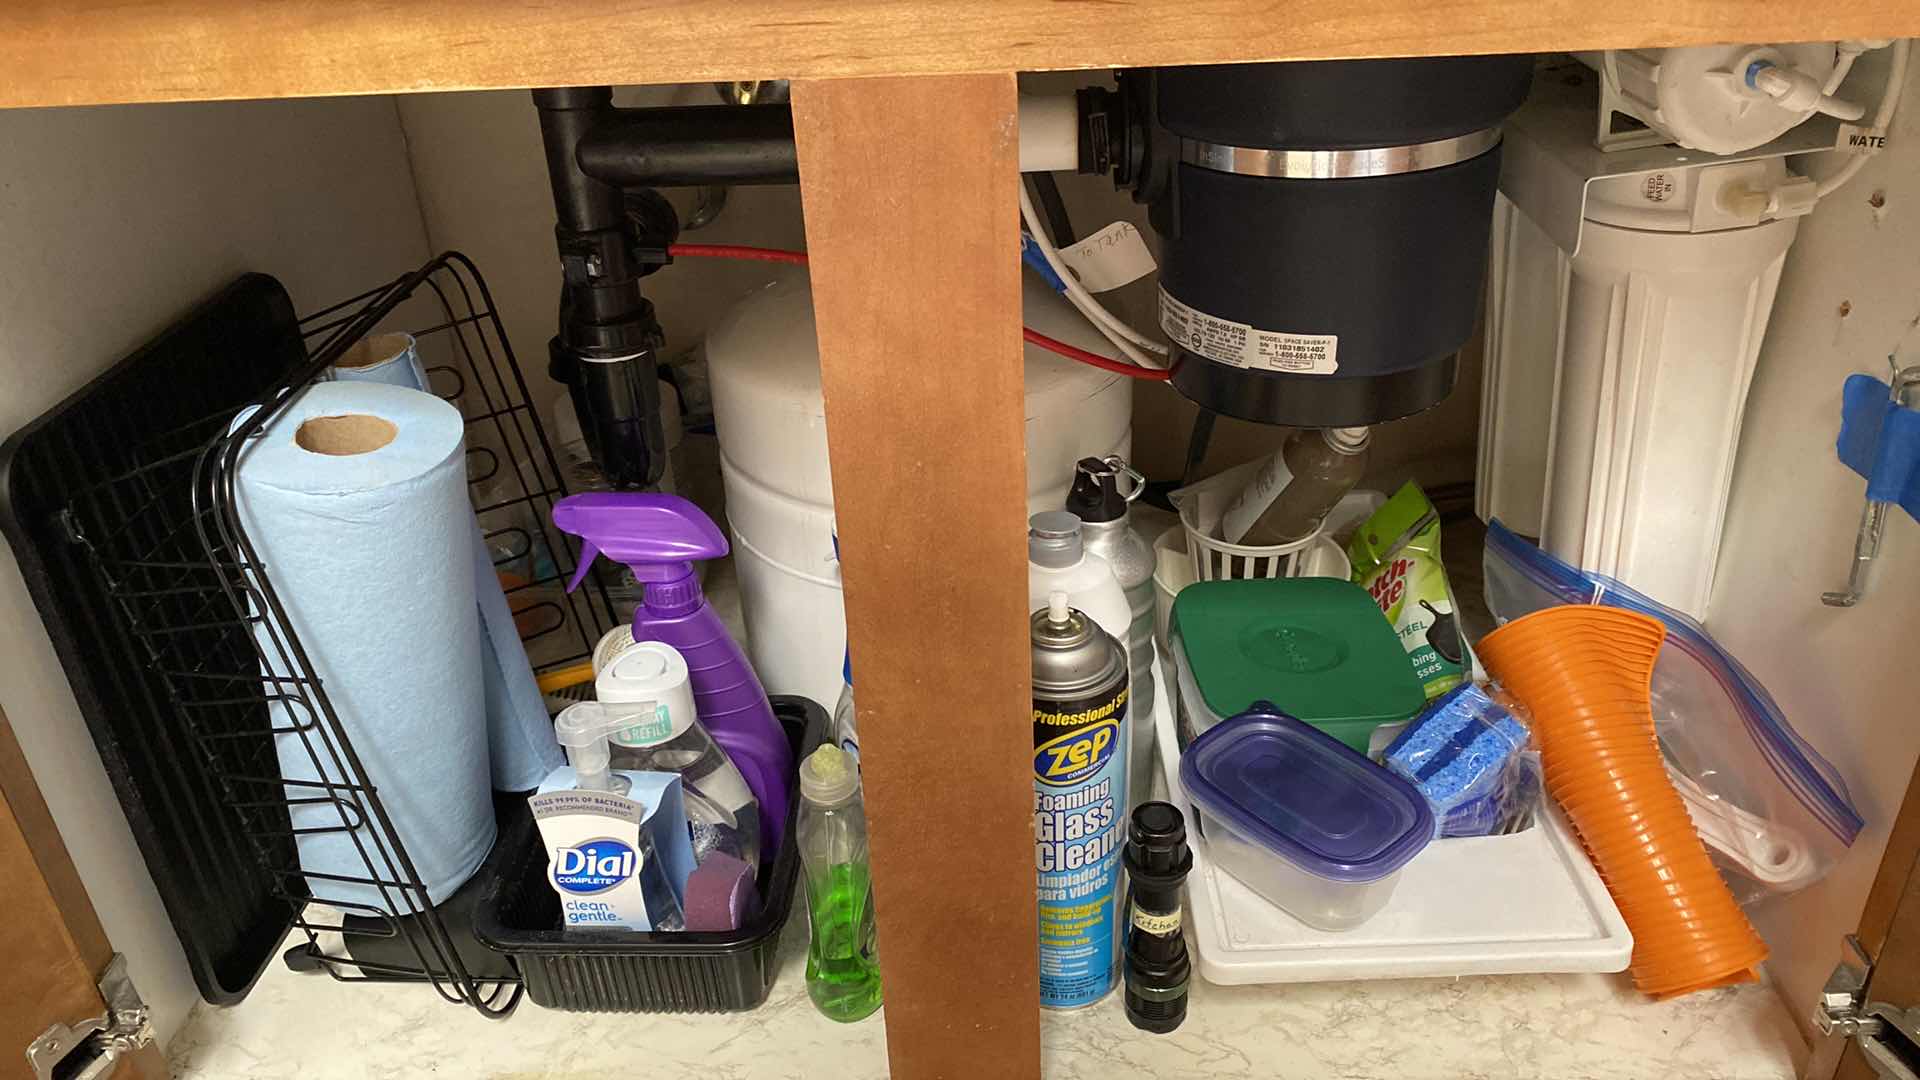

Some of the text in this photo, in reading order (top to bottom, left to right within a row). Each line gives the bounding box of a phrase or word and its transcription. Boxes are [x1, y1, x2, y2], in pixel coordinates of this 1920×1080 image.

[1655, 174, 1664, 201] WATER
[1664, 183, 1672, 192] IN
[1033, 698, 1116, 727] Professional
[582, 796, 593, 804] OF
[1036, 777, 1111, 812] Foaming
[1036, 798, 1114, 842] Glass
[556, 847, 634, 878] Dial
[566, 900, 609, 911] clean
[568, 911, 617, 924] gentle
